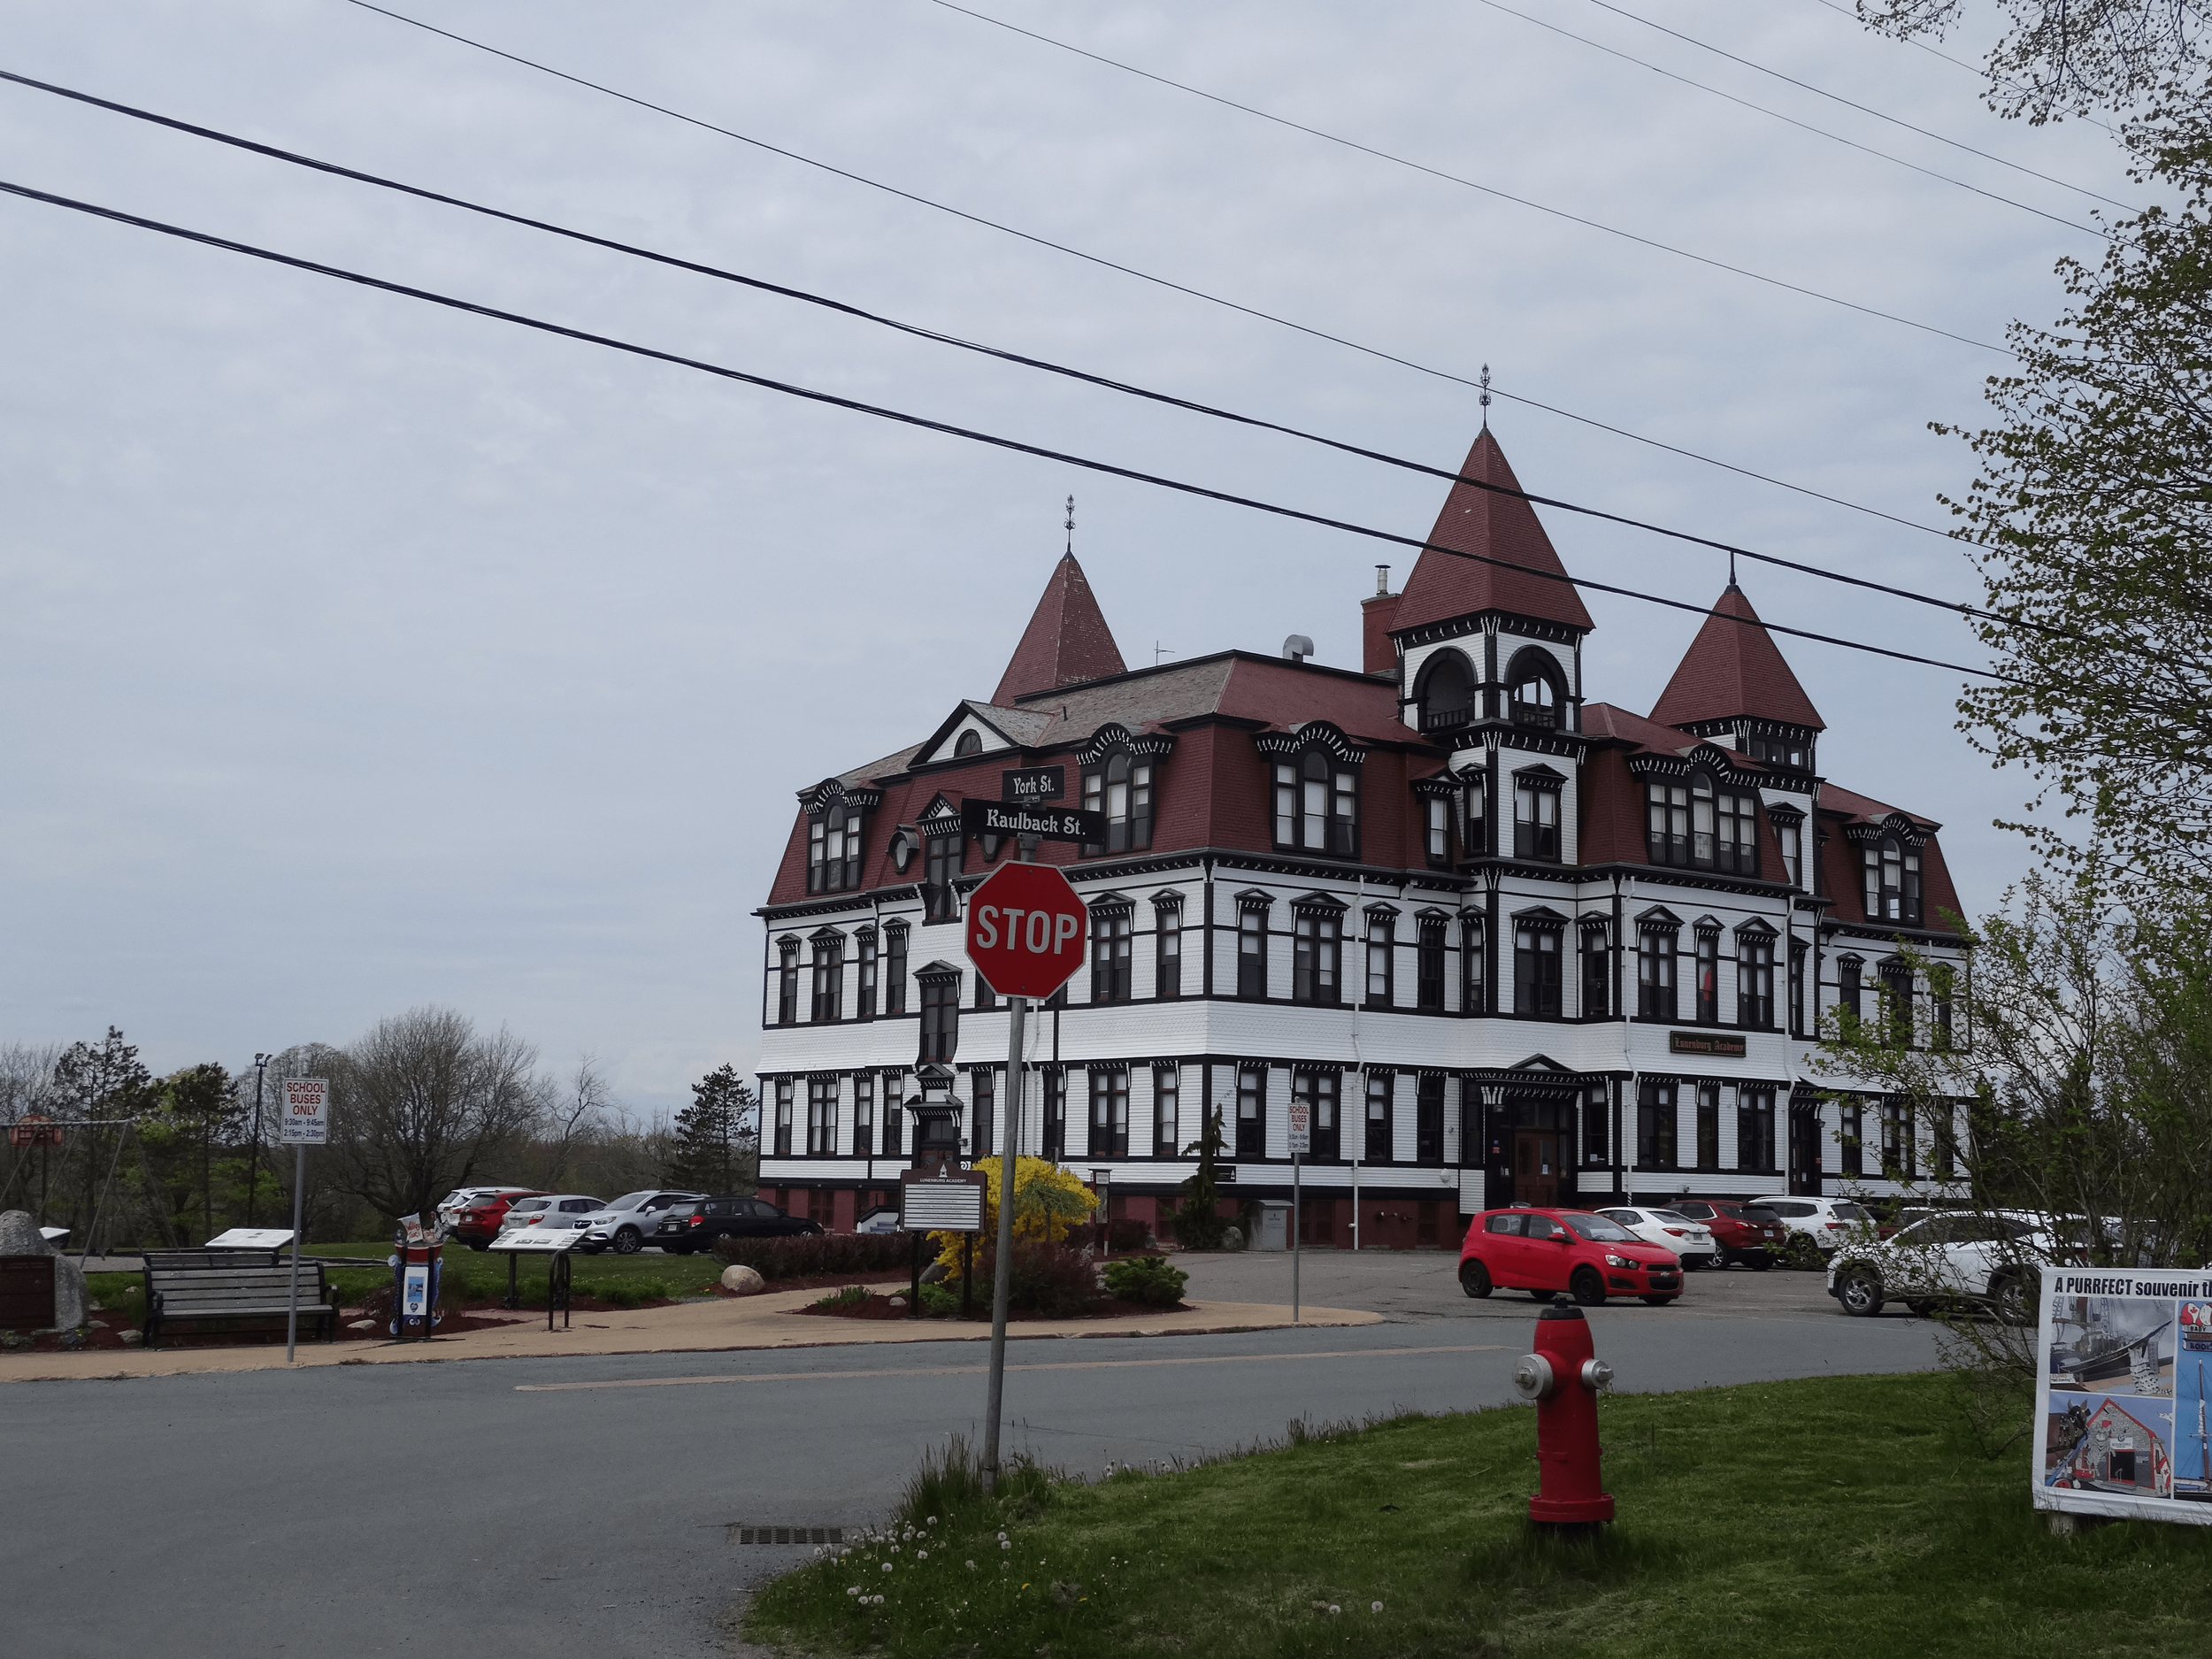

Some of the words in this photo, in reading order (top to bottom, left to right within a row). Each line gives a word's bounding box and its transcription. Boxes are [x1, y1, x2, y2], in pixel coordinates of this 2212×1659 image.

[1013, 776, 1037, 795] York
[1040, 775, 1055, 793] St.
[987, 809, 1058, 833] Kaulback
[1063, 816, 1086, 835] St.
[976, 904, 1078, 955] STOP
[1674, 1037, 1712, 1051] Lunenburg
[1714, 1040, 1744, 1052] Academy
[287, 1082, 326, 1093] SCHOOL
[290, 1094, 321, 1104] BUSES
[293, 1105, 318, 1115] ONLY
[2055, 1277, 2063, 1293] A
[2066, 1277, 2133, 1295] PURRFECT
[2135, 1280, 2199, 1297] souvenir
